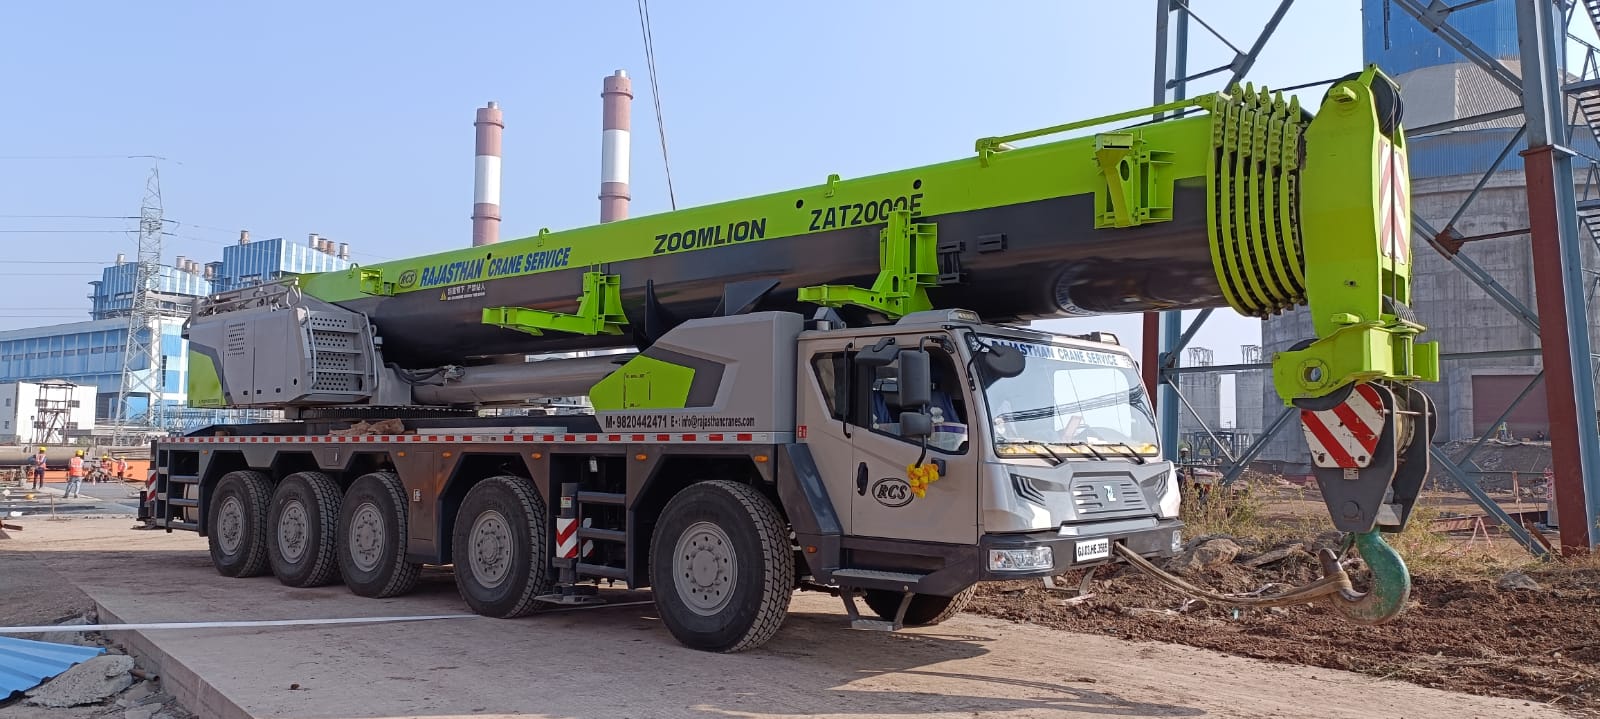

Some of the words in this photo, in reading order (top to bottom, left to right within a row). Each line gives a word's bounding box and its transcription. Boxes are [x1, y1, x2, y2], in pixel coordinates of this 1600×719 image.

[653, 218, 767, 255] ZOOMLION
[420, 258, 485, 288] RAJASTHAN
[488, 254, 524, 277] CRANE
[524, 246, 572, 272] SERVICE
[1058, 347, 1084, 362] CRANE
[1085, 351, 1119, 366] SERVICE
[876, 483, 909, 501] RCS
